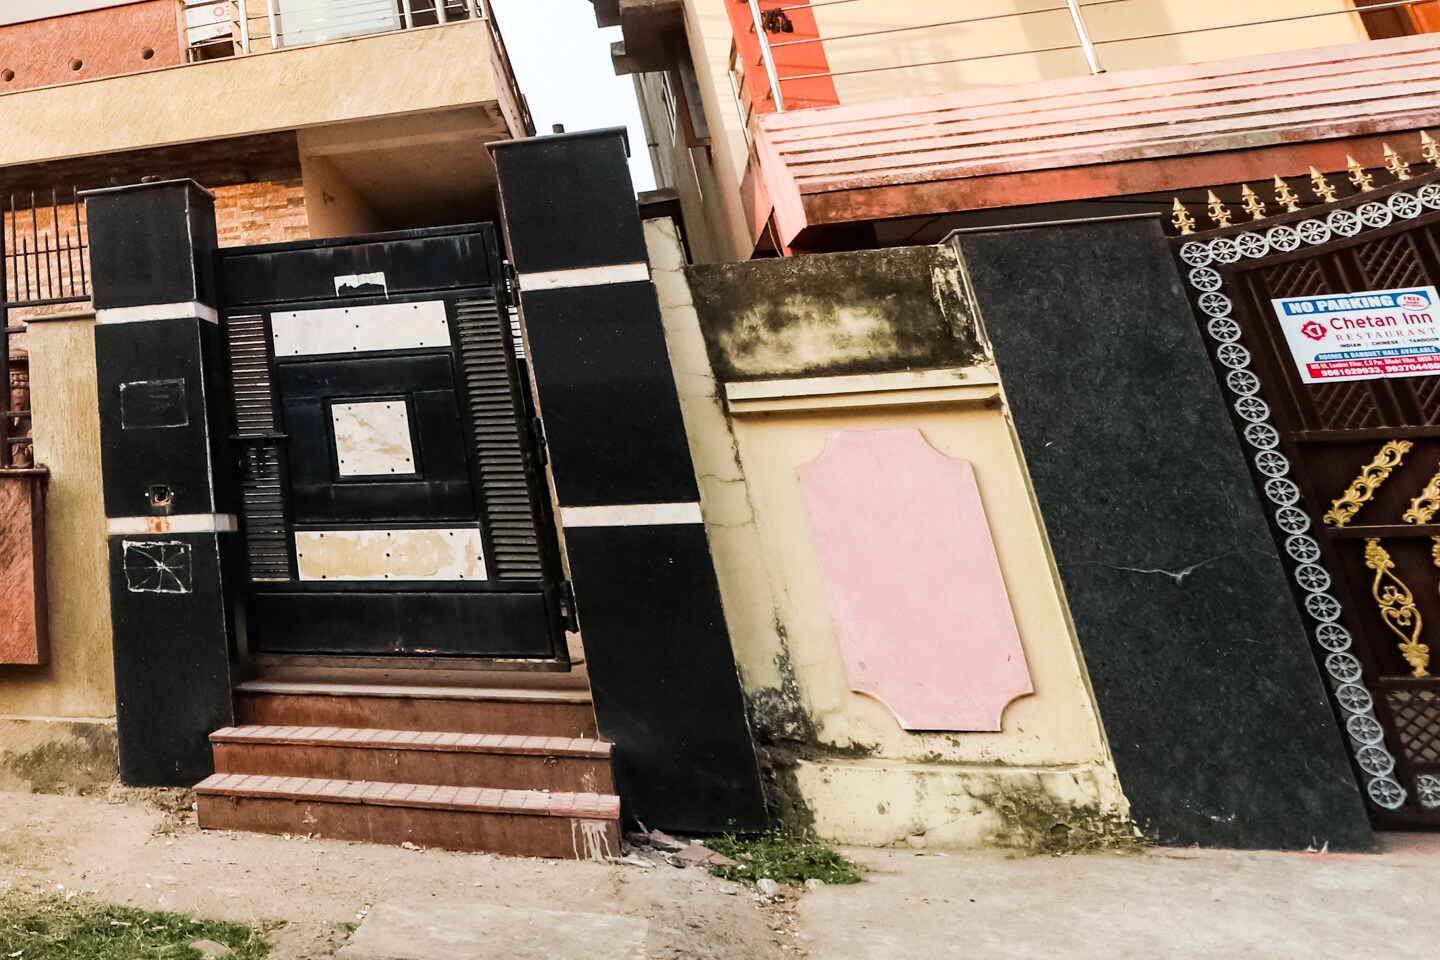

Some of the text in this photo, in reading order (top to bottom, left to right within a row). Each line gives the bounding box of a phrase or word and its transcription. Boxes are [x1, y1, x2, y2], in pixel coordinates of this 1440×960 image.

[1288, 295, 1395, 314] NO PARKING
[1329, 312, 1433, 330] Chetan Inn
[1335, 327, 1436, 341] RESTAURANT
[1350, 350, 1381, 358] BANQUET
[1400, 346, 1437, 355] AVAILABLE
